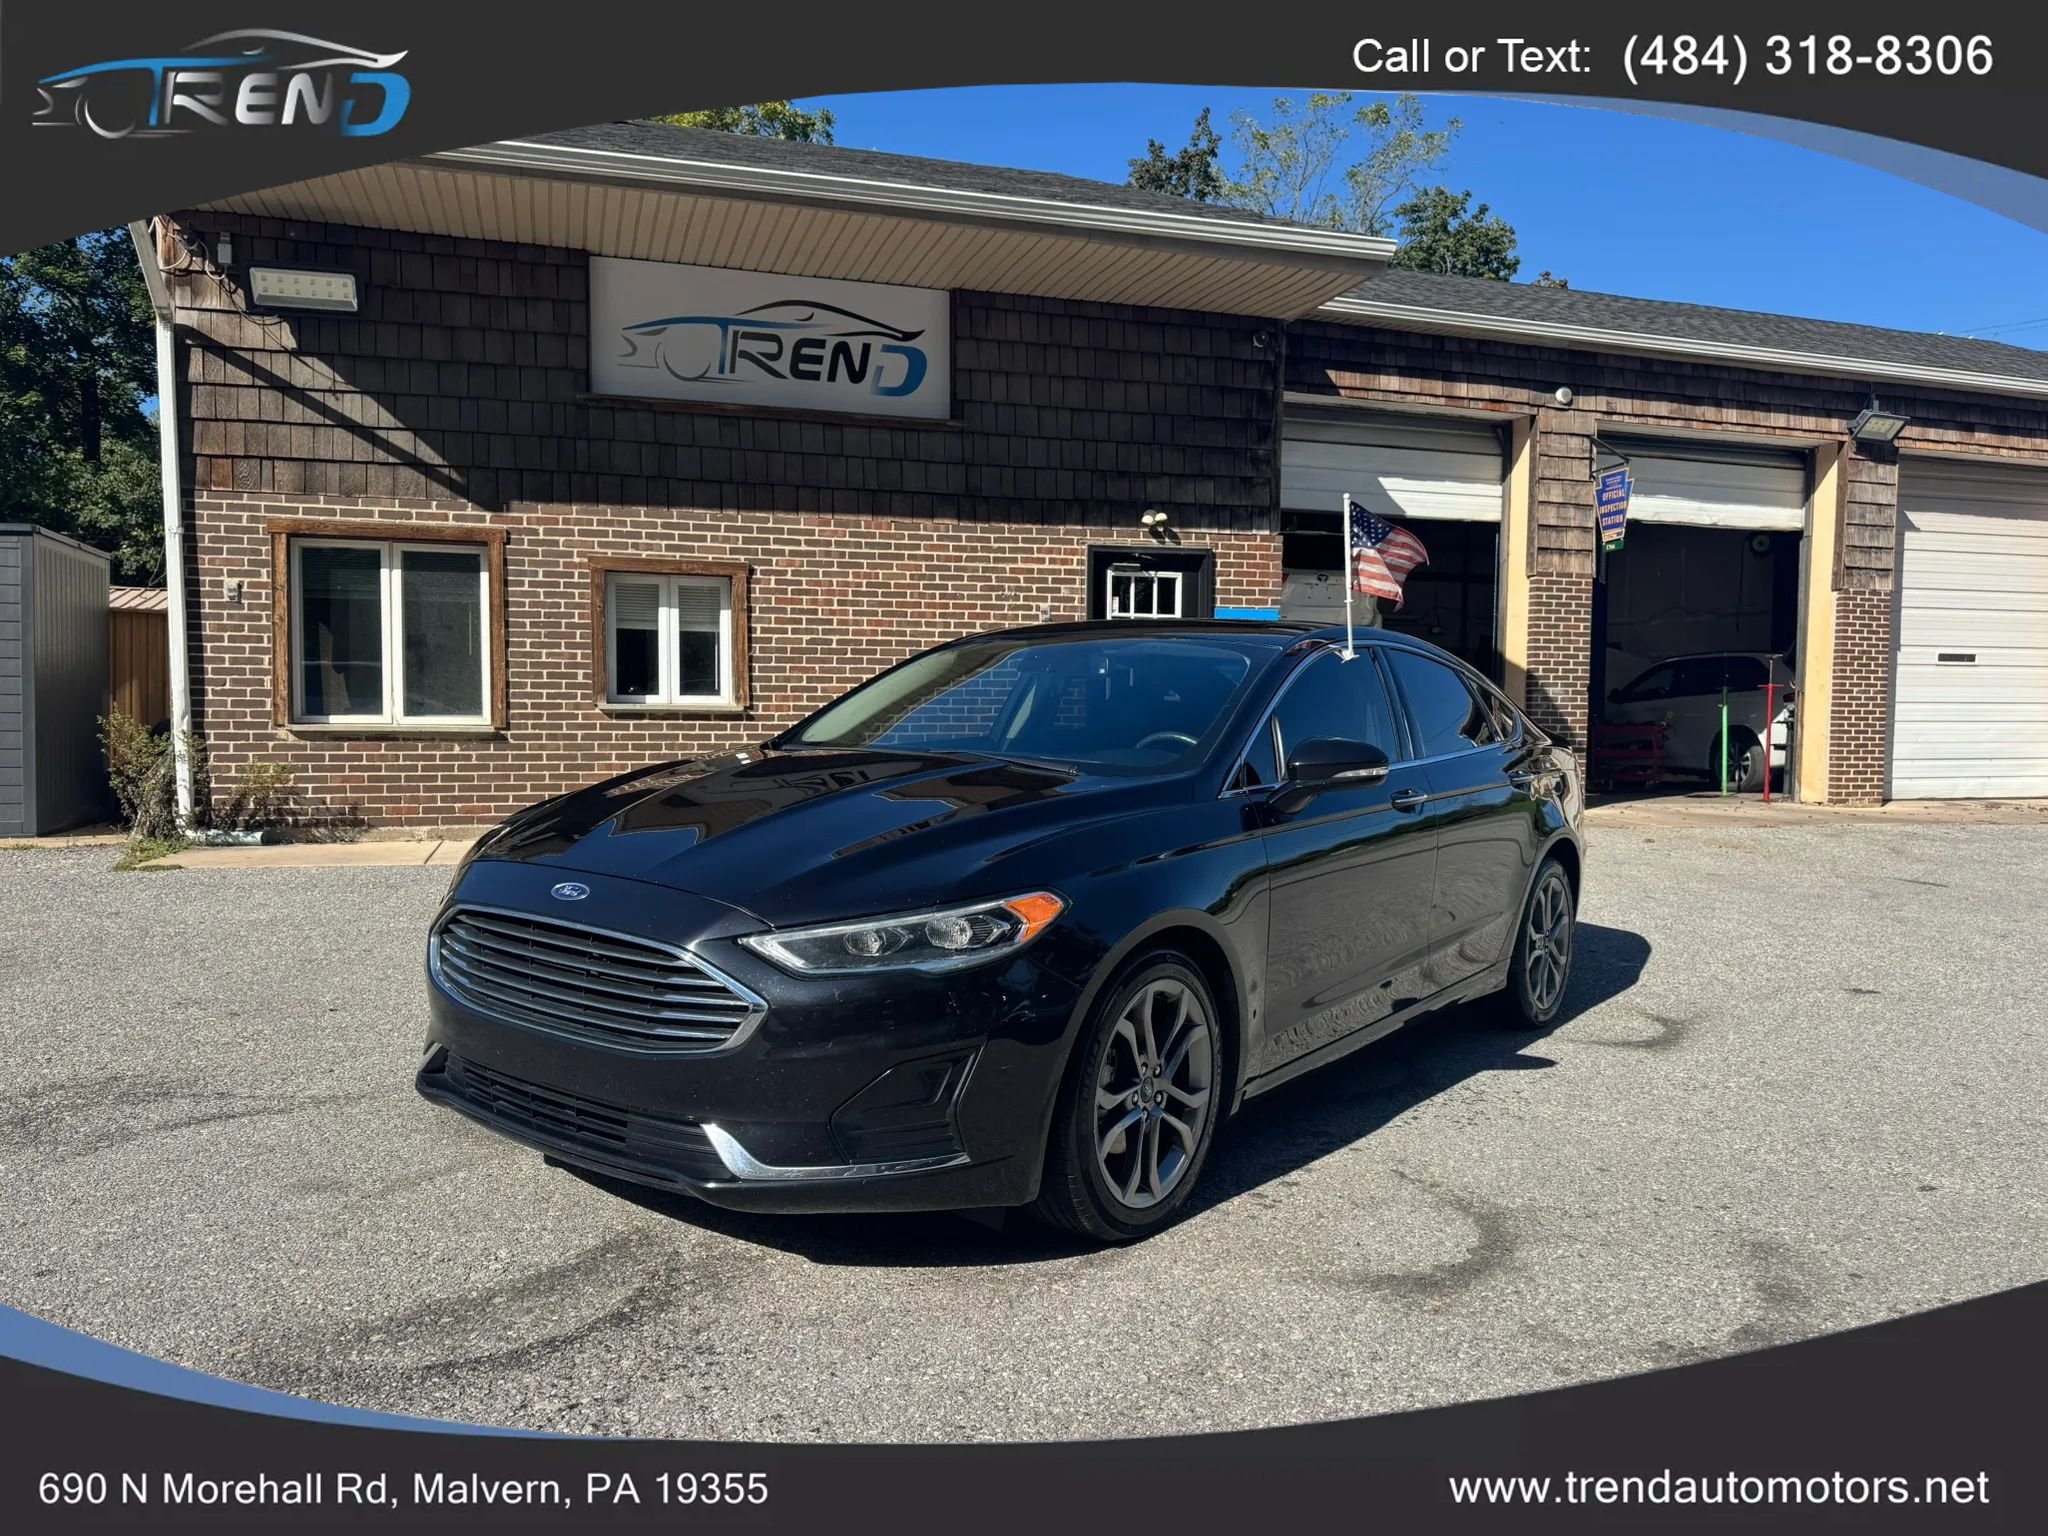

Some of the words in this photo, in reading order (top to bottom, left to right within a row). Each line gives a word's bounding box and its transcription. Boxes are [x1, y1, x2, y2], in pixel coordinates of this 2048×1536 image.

[680, 316, 928, 397] TREND
[1602, 489, 1625, 501] OFFICIAL
[1599, 501, 1628, 514] INSPECTION
[1602, 514, 1624, 527] STATION
